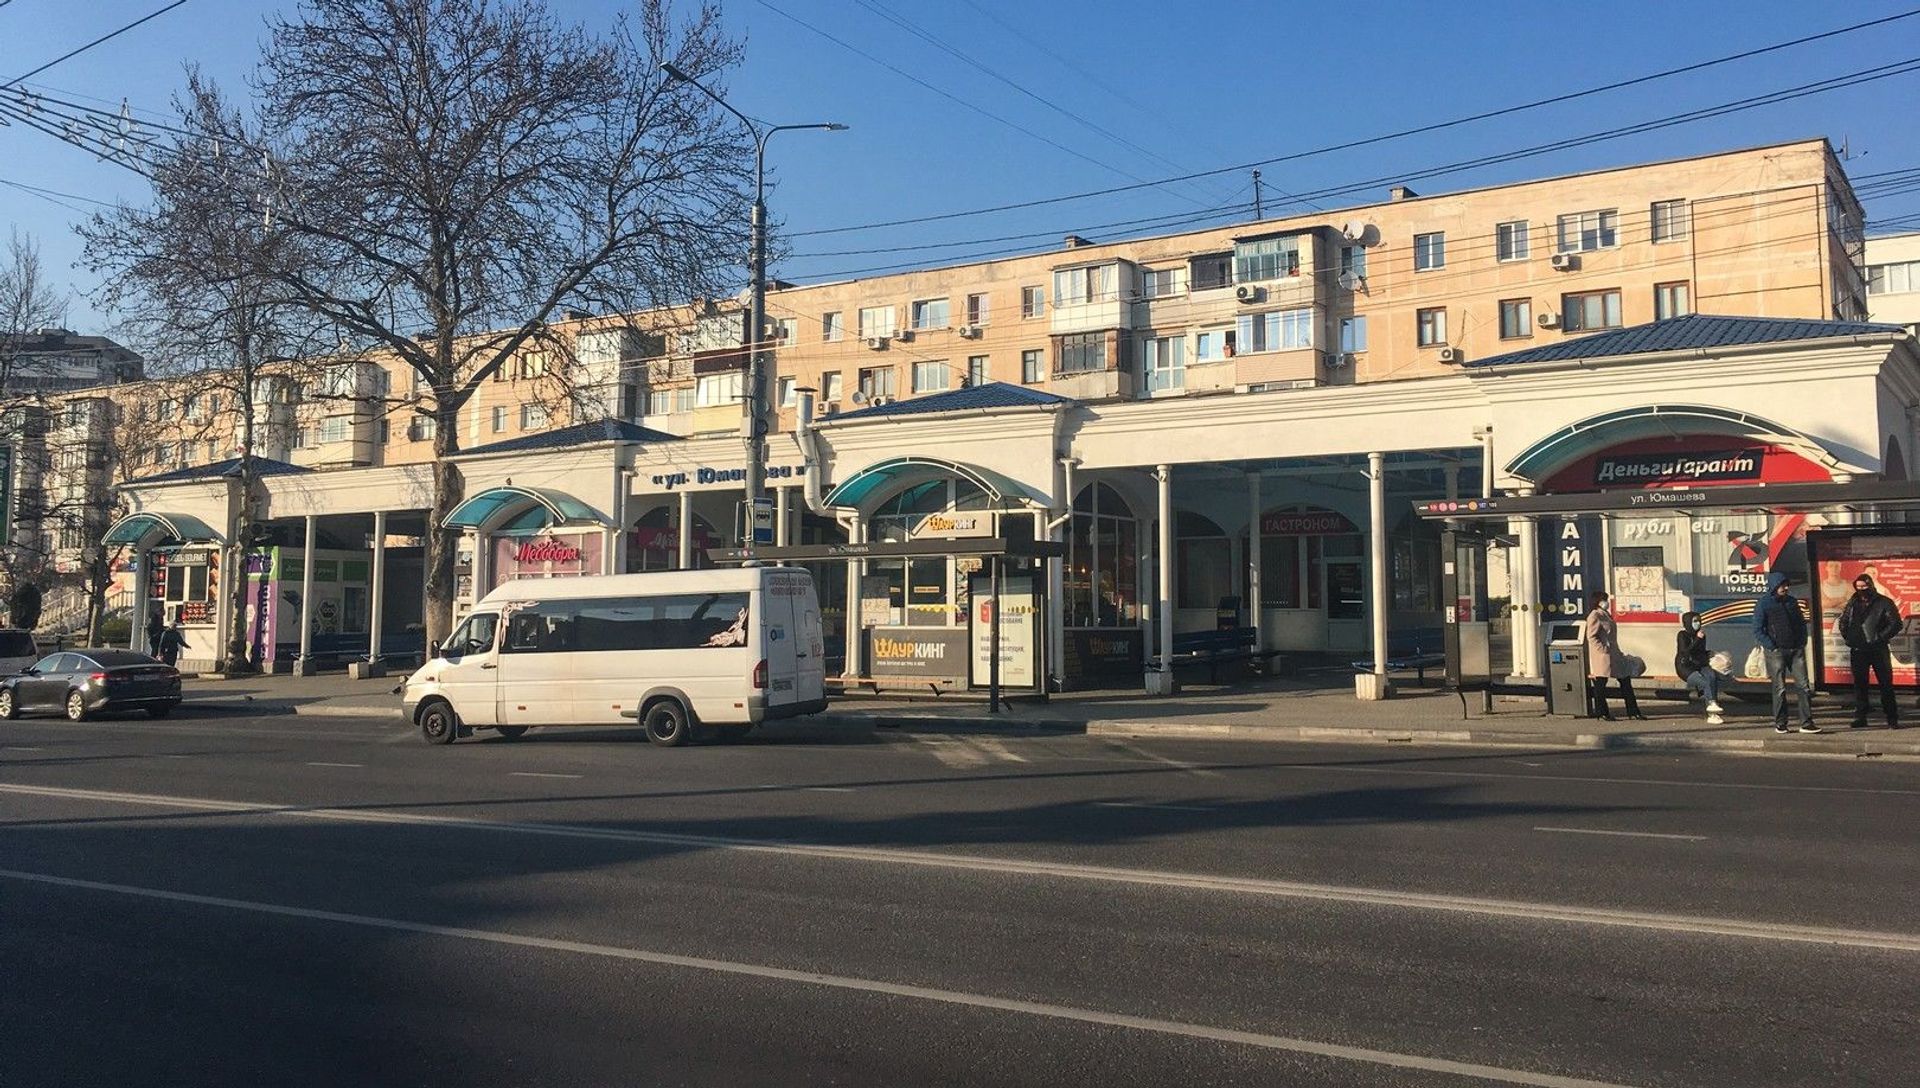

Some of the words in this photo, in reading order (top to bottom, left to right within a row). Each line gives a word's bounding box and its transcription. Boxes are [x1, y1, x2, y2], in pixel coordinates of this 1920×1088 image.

[1598, 457, 1754, 481] ДеньгиГарант
[1630, 494, 1647, 504] ул.
[1650, 492, 1706, 503] Юмашева
[1264, 516, 1340, 531] ГАСТРОНОМ
[1561, 513, 1583, 615] АЙМЫ
[1720, 574, 1768, 585] ПОБЕД
